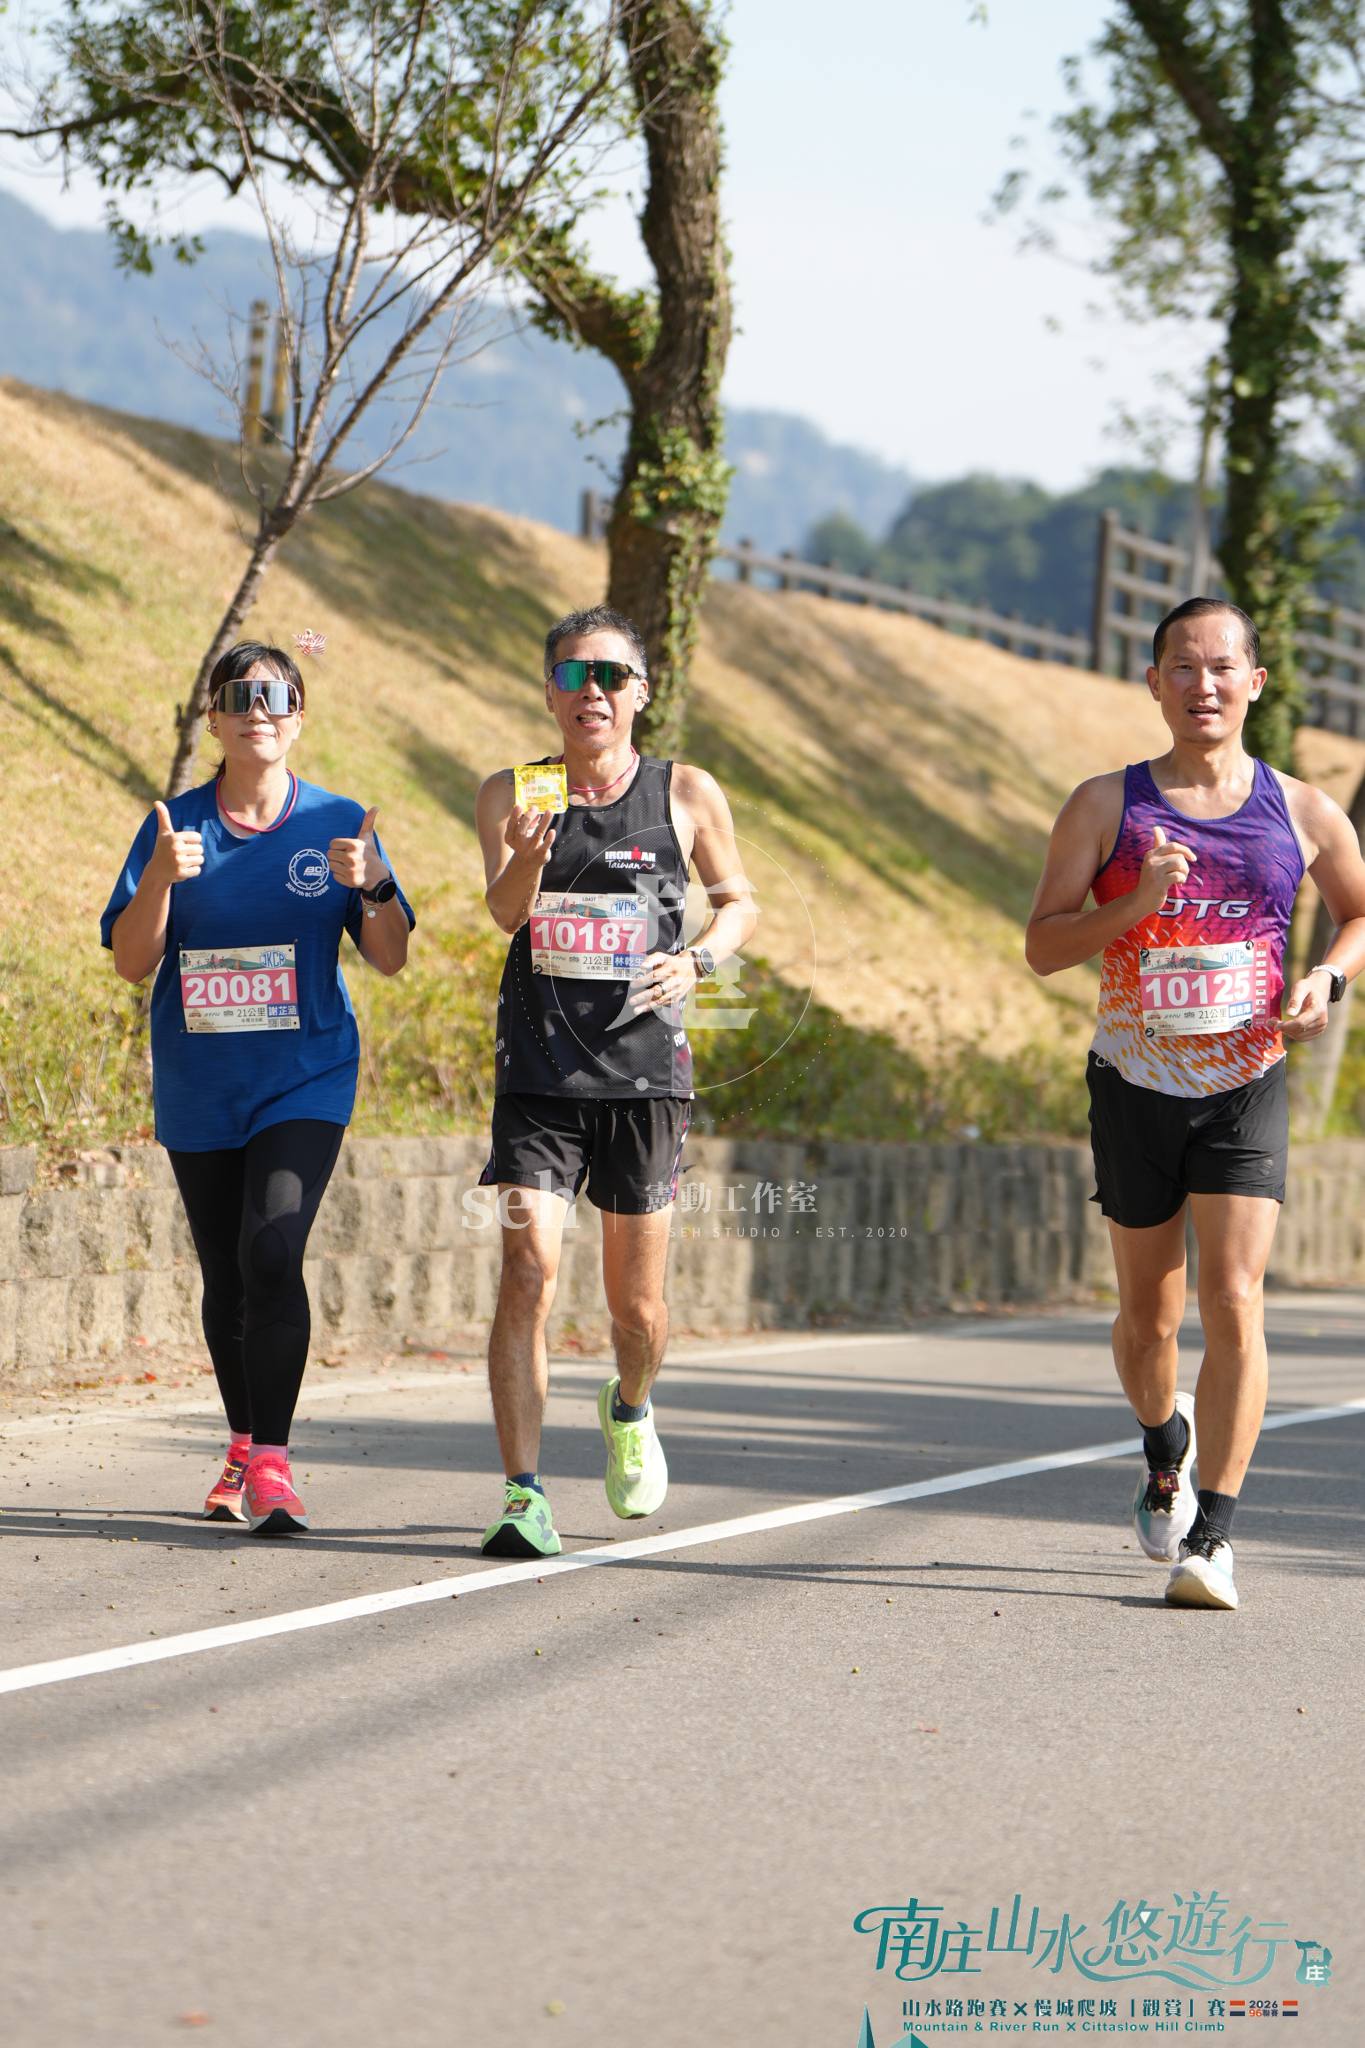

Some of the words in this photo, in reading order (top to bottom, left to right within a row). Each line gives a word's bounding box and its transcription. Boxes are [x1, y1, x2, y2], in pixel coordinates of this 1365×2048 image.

[604, 846, 656, 862] IRONMAN
[605, 860, 641, 870] Taiwan
[1158, 898, 1254, 920] JTG
[534, 920, 643, 952] 10187
[583, 955, 612, 966] 21公里
[185, 972, 291, 1006] 20081
[1145, 970, 1251, 1008] 10125
[237, 1007, 266, 1018] 21公里
